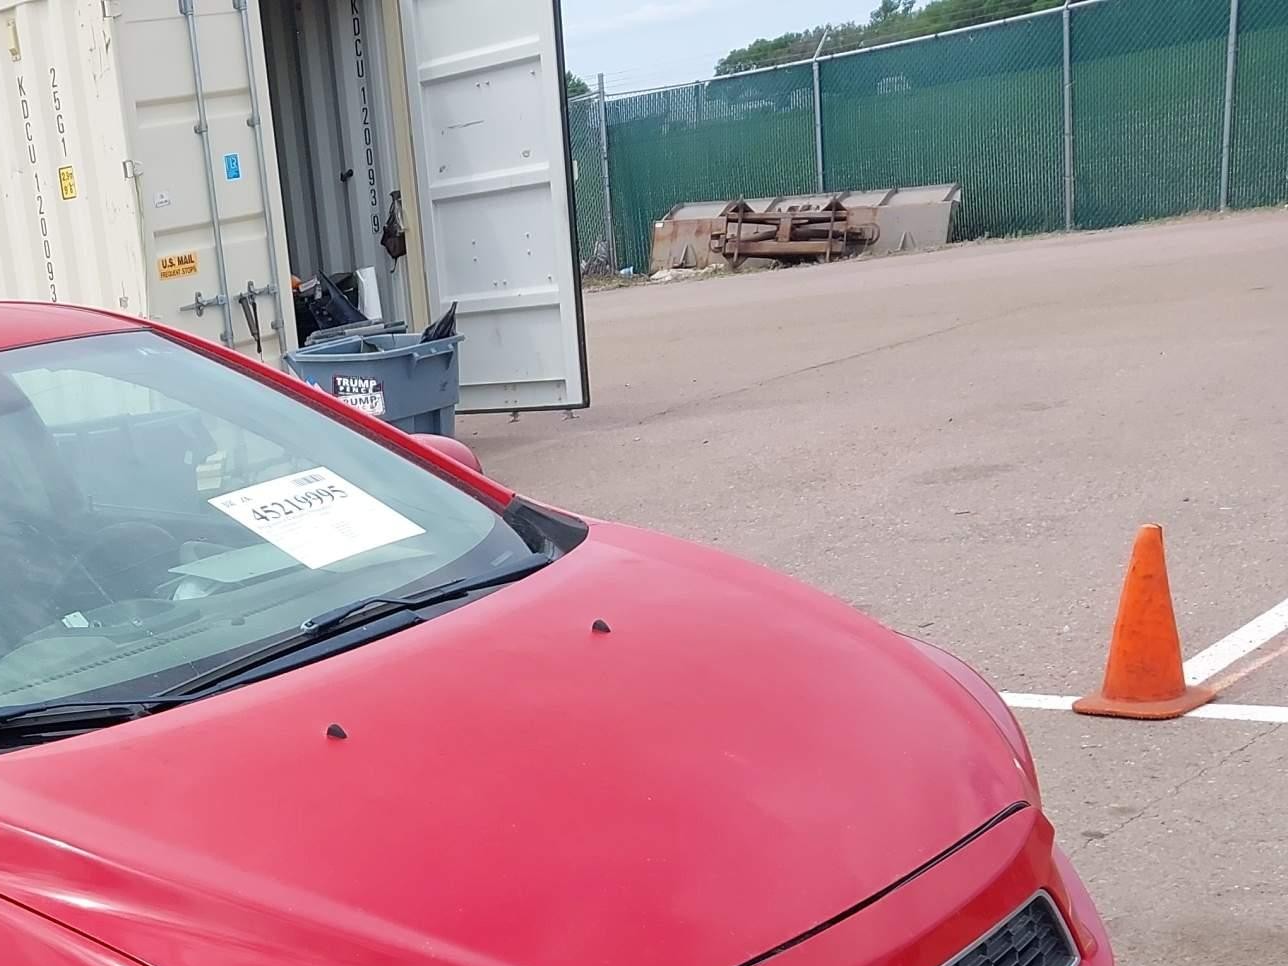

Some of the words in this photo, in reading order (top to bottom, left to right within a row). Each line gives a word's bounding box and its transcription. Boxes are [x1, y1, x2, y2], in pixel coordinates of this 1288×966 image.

[50, 67, 67, 157] 25G1
[161, 257, 176, 269] U.S.
[177, 253, 195, 266] MAIL
[336, 376, 377, 388] TRUMP
[250, 485, 349, 523] 45219995
